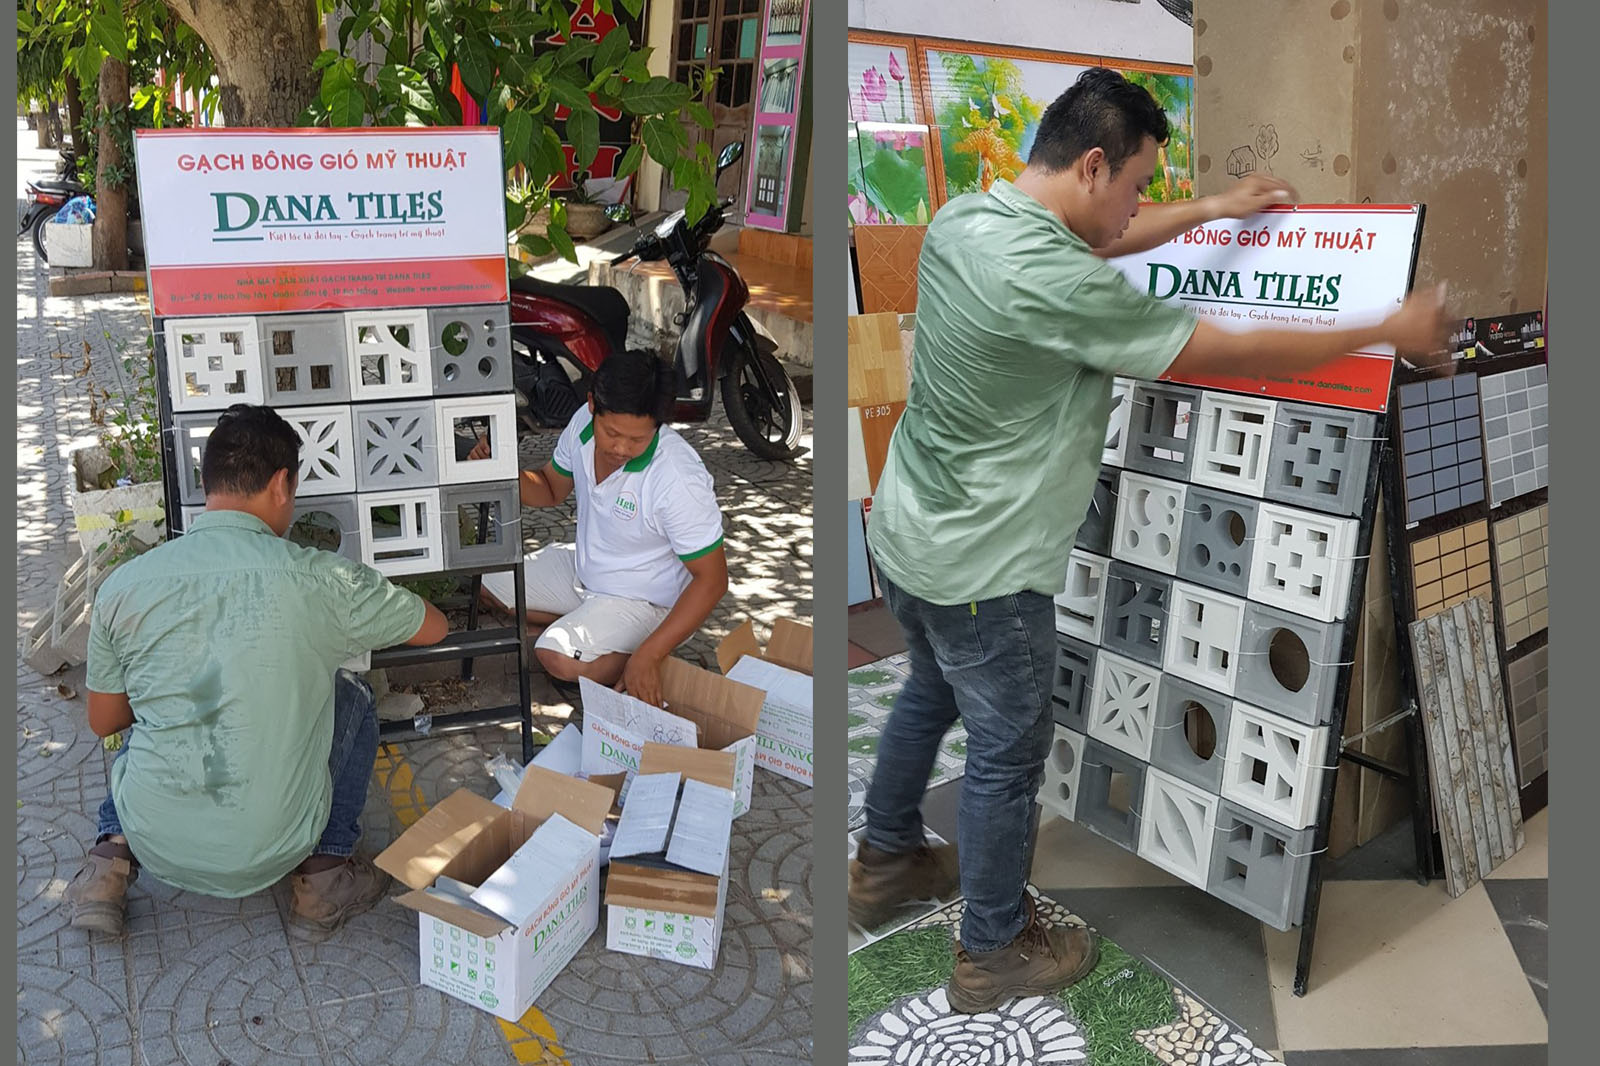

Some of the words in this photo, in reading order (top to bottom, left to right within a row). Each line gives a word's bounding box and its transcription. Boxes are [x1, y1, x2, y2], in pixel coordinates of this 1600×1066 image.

[177, 154, 244, 174] GẠCH
[252, 150, 313, 171] BÔNG
[320, 149, 358, 170] GIÓ
[366, 149, 397, 169] MỸ
[406, 148, 467, 172] THUẬT
[210, 192, 340, 232] DANA
[348, 190, 443, 224] TILES
[1184, 225, 1232, 246] BÔNG
[1237, 226, 1270, 247] GIÓ
[1277, 227, 1306, 248] MỸ
[1314, 228, 1377, 253] THUẬT
[1147, 263, 1244, 300] DANA
[1254, 270, 1341, 307] TILES
[1231, 308, 1241, 320] tay
[1249, 309, 1269, 322] Gạch
[1270, 312, 1289, 324] trang
[1315, 315, 1336, 326] thuật
[876, 404, 891, 417] 305
[601, 740, 637, 768] DANA
[534, 910, 565, 953] DANA
